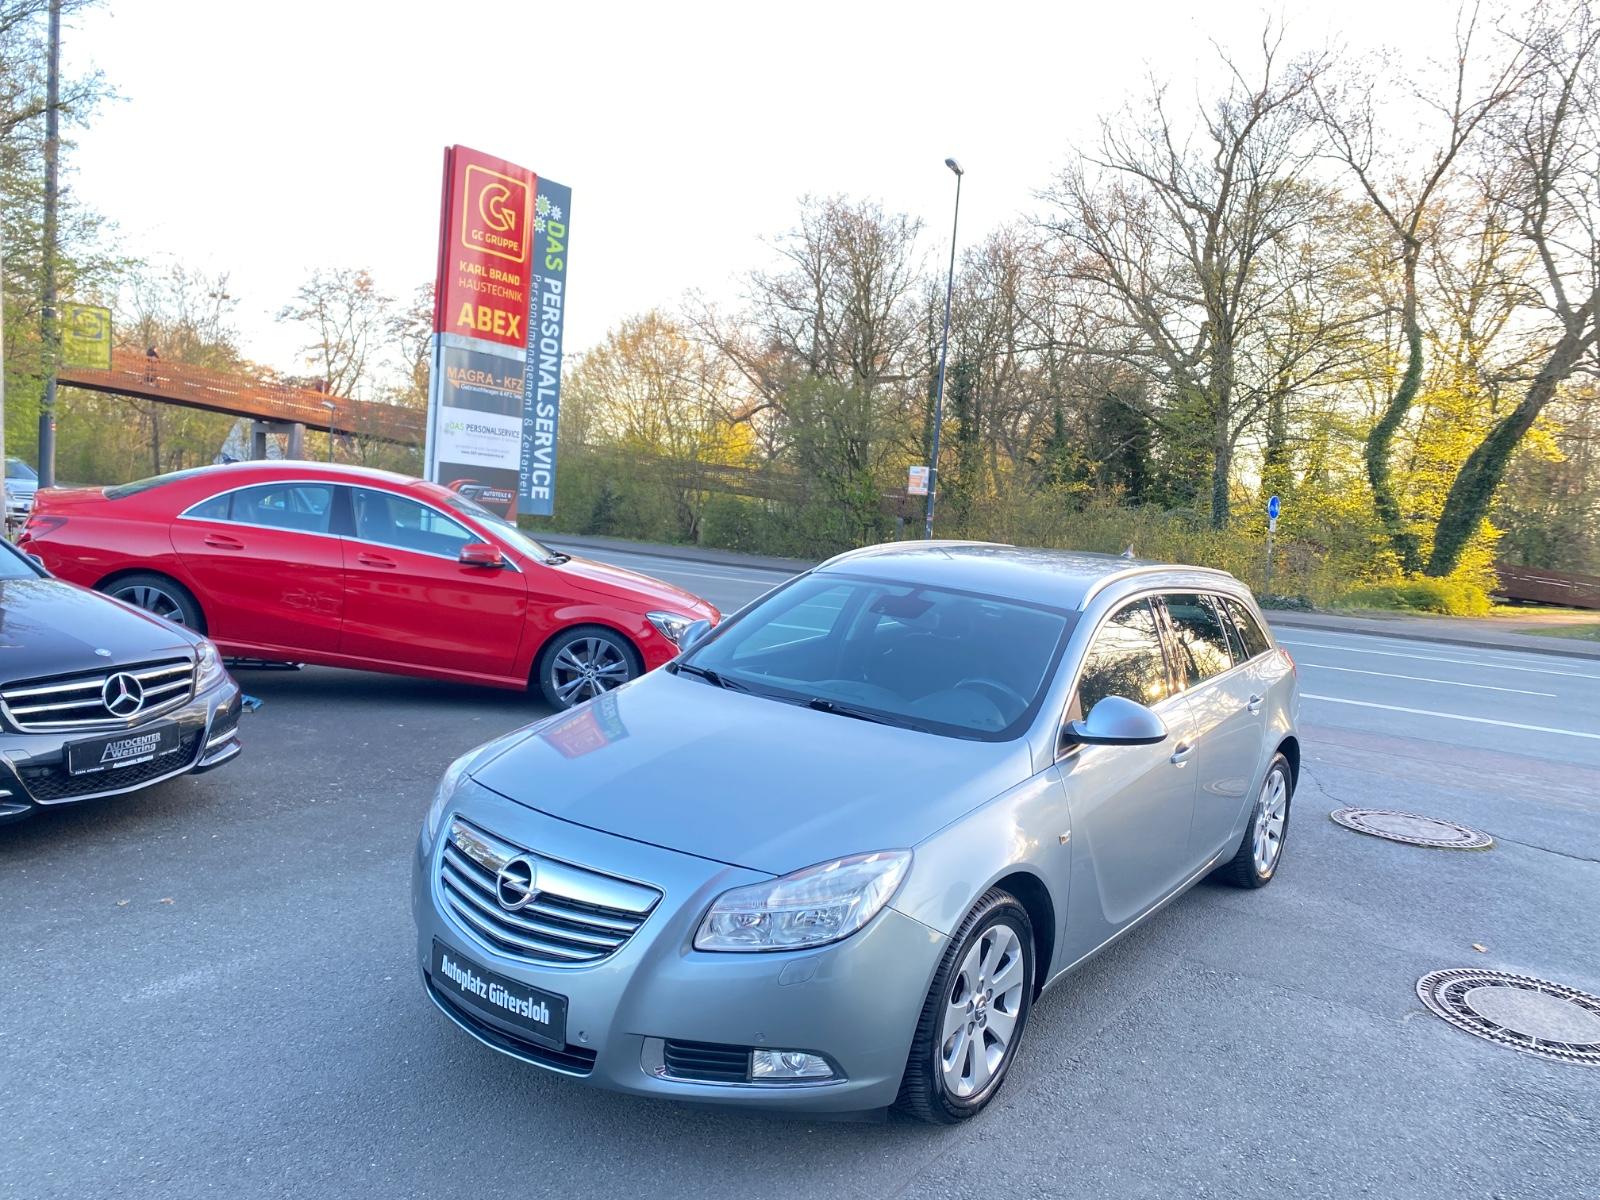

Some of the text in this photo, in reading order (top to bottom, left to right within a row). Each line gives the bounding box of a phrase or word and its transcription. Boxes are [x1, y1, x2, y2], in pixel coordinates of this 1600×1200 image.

[471, 229, 519, 252] GC GRUPPE
[459, 260, 520, 286] KARL BRAND
[458, 277, 523, 302] HAUSTECHNIK
[457, 302, 521, 339] ABEX
[524, 274, 542, 411] Personalmanagement
[531, 220, 566, 499] DAS PERSONALSERVICE
[447, 367, 494, 385] MAGRA
[503, 375, 523, 391] KFZ
[466, 423, 520, 439] PERSONALSERVICE
[101, 732, 161, 762] AUTOCENTER
[113, 743, 156, 758] Westring
[441, 954, 549, 1025] Autoplatz Gütersloh
